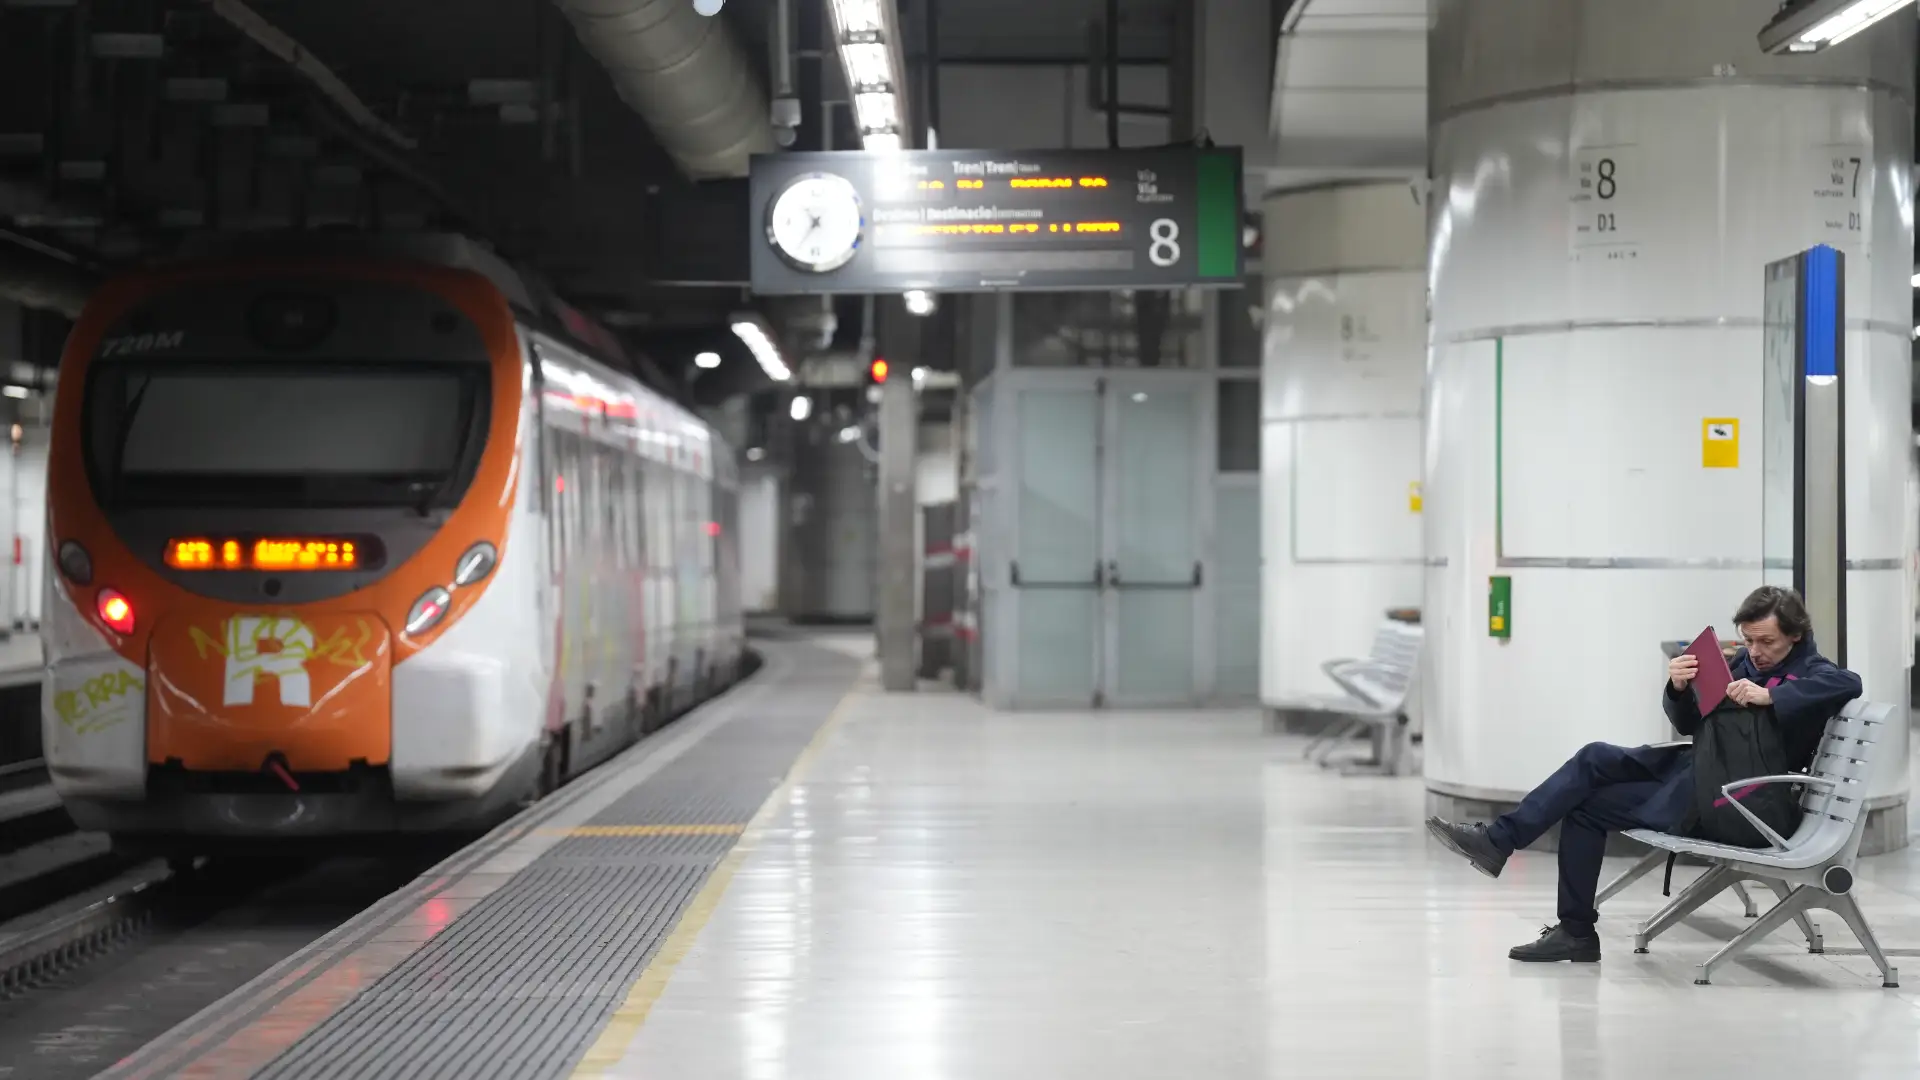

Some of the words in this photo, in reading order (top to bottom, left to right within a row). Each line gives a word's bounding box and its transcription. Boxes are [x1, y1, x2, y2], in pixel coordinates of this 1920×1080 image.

[1598, 158, 1616, 199] 8
[1849, 157, 1861, 198] 7
[1597, 212, 1617, 232] D1
[1849, 210, 1861, 230] D1
[1149, 218, 1181, 267] 8
[223, 616, 315, 707] R
